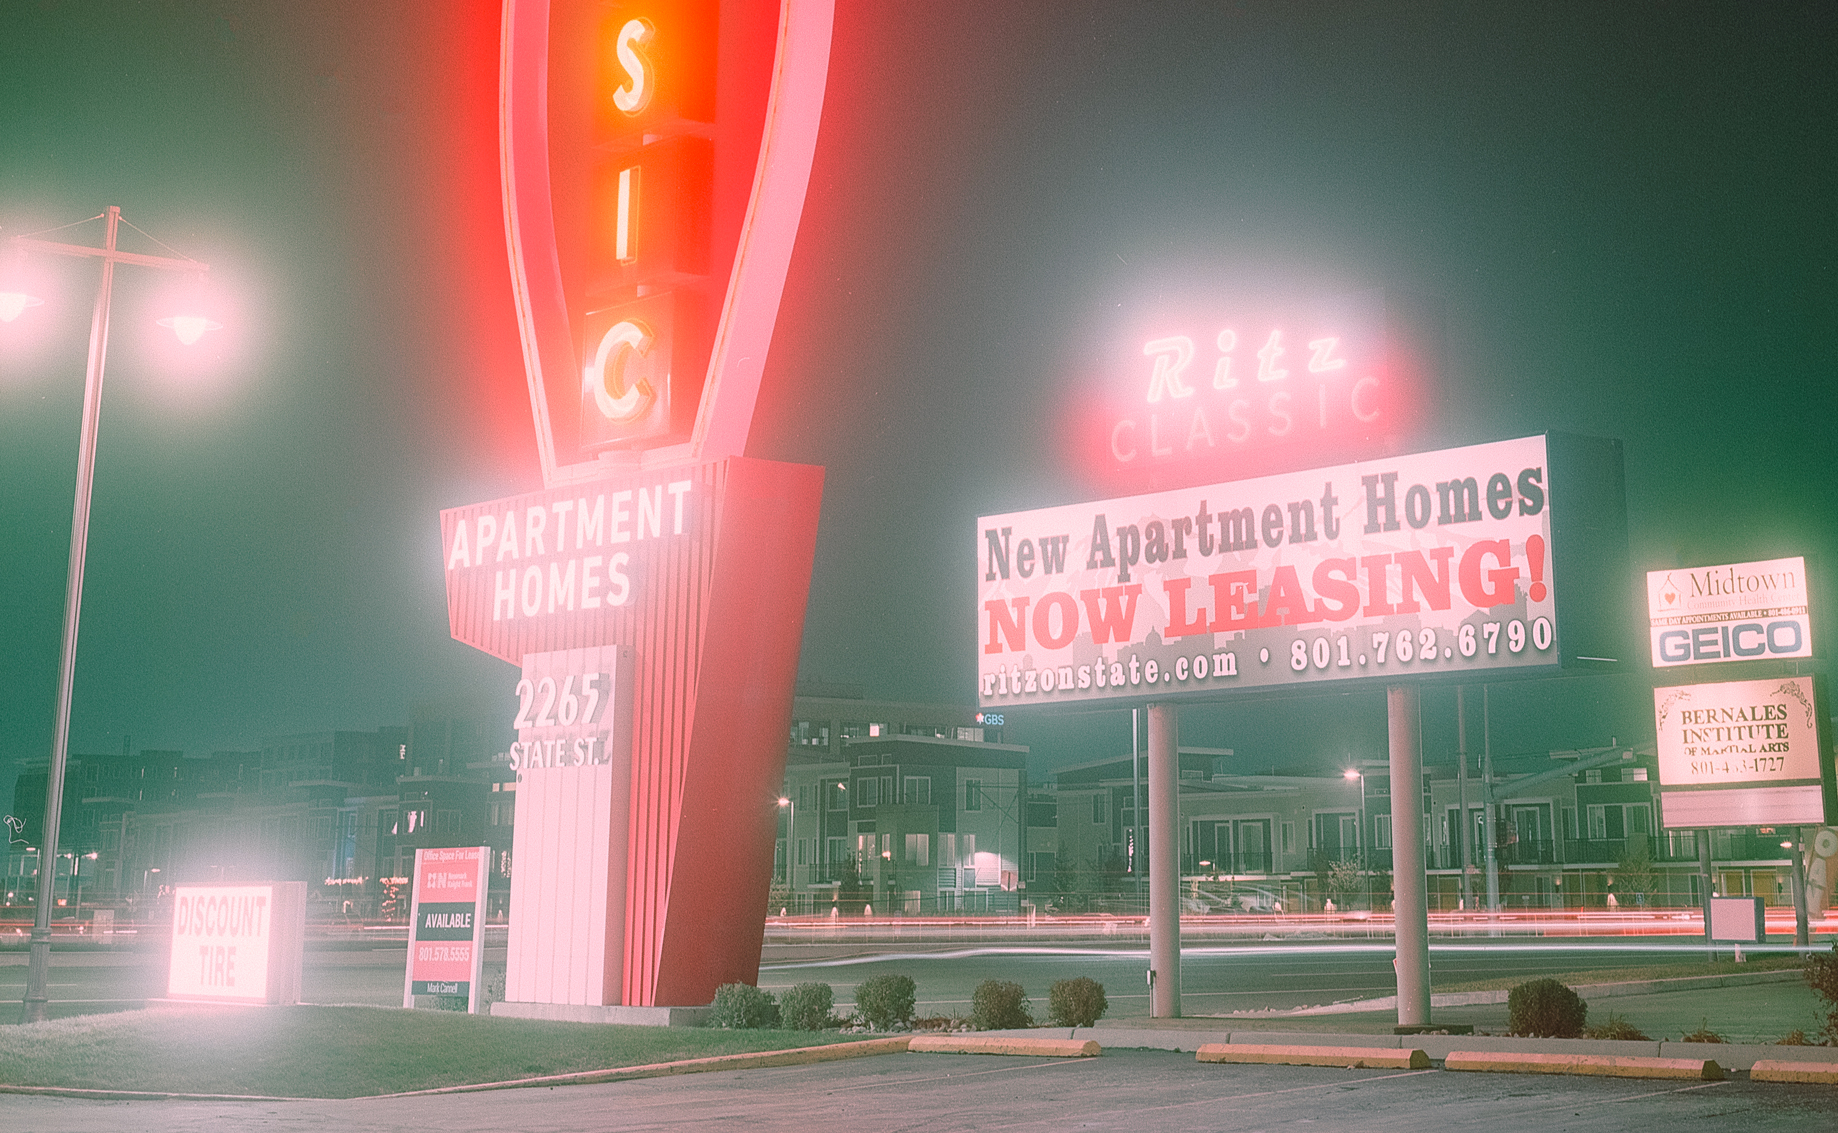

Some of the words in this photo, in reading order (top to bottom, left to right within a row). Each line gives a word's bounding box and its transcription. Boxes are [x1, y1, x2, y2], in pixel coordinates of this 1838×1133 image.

[1143, 329, 1347, 403] Ritz
[1111, 376, 1380, 462] CLASSIC
[448, 480, 692, 570] APARTMENT
[985, 526, 1069, 582] New
[1086, 481, 1341, 583] Apartment
[1361, 467, 1545, 535] Homes
[493, 552, 630, 621] HOMES
[984, 584, 1142, 654] NOW
[1164, 534, 1547, 638] LEASING!
[1687, 596, 1737, 609] Community
[1739, 593, 1768, 606] Health
[1770, 590, 1801, 603] Center
[1690, 567, 1796, 598] Midtown
[1668, 616, 1681, 625] DAY
[1681, 613, 1729, 624] APPOINTMENTS
[1729, 610, 1763, 620] AVAILABLE
[983, 651, 1237, 696] ritzonstate.com
[1290, 616, 1552, 671] 801.762.6790
[1659, 620, 1802, 663] GEICO
[513, 672, 600, 730] 2265
[1681, 704, 1788, 725] BERNALES
[984, 713, 1005, 726] GBS
[1682, 723, 1789, 744] INSTITUTE
[509, 739, 567, 771] STATE
[573, 736, 600, 767] ST.
[1684, 747, 1697, 756] OF
[1759, 742, 1790, 753] ARTS
[423, 850, 439, 861] Office
[439, 850, 455, 863] Space
[455, 850, 464, 861] For
[177, 895, 267, 937] DISCOUNT
[425, 913, 472, 928] AVAILABLE
[200, 945, 237, 987] TIRE
[418, 947, 470, 962] 801.578.5555
[427, 982, 440, 993] Mark
